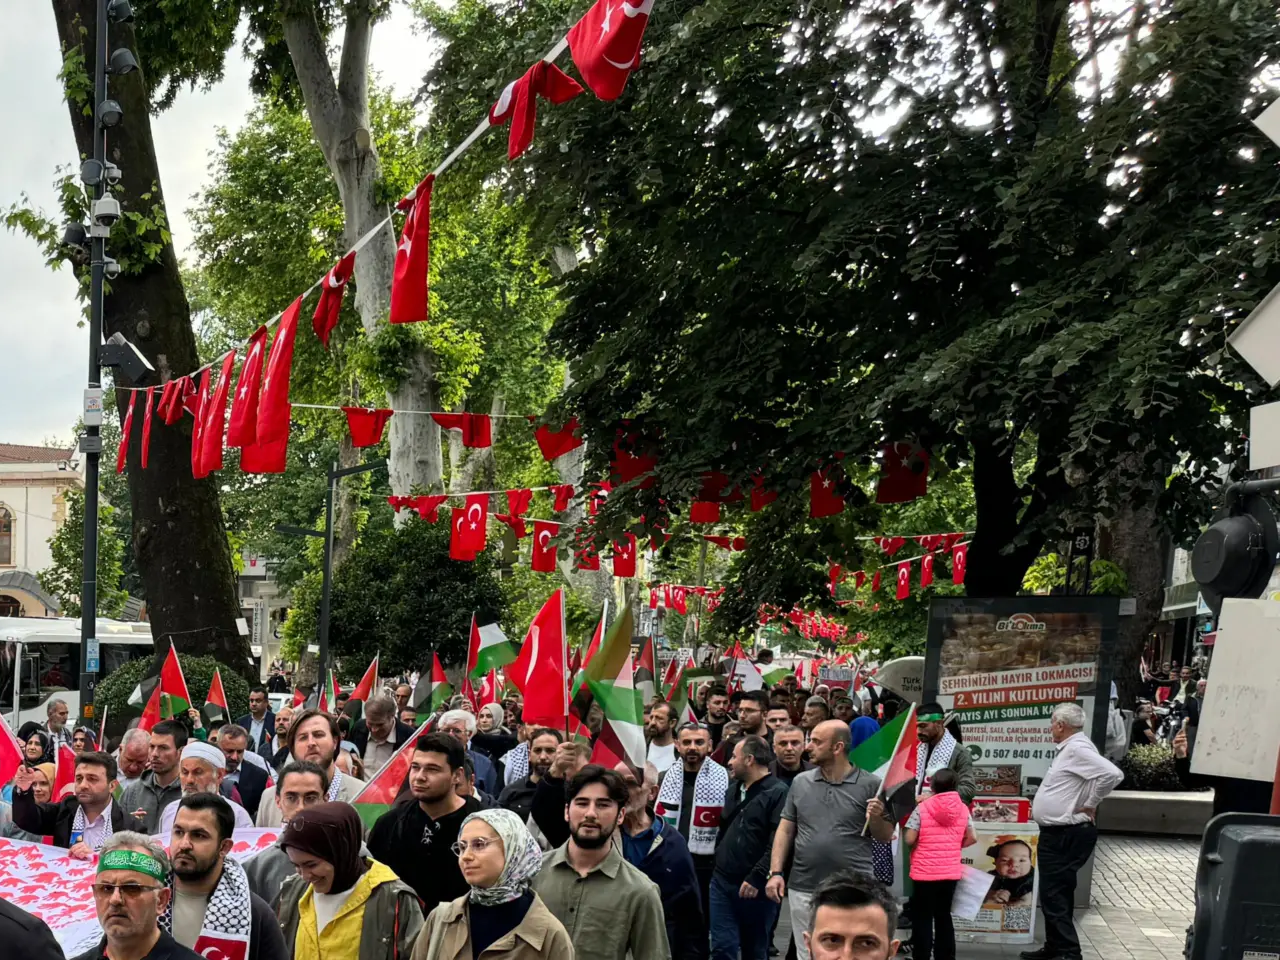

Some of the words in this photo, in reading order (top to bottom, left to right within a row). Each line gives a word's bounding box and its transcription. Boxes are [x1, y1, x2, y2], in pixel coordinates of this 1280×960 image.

[902, 676, 921, 684] Türk
[942, 674, 998, 692] ŞEHRİNİZİN
[1001, 671, 1033, 685] HAYIR
[1035, 667, 1093, 681] LOKMACISI
[957, 693, 968, 706] 2.
[971, 690, 1005, 704] YILINI
[1009, 686, 1075, 702] KUTLUYOR!
[983, 709, 998, 720] AYI
[1001, 706, 1039, 718] SONUNA
[1006, 727, 1041, 735] ÇARŞAMBA
[1015, 734, 1028, 744] İÇİN
[984, 749, 991, 758] 0
[993, 749, 1010, 758] 507
[1012, 749, 1030, 758] 840
[1032, 749, 1043, 759] 41
